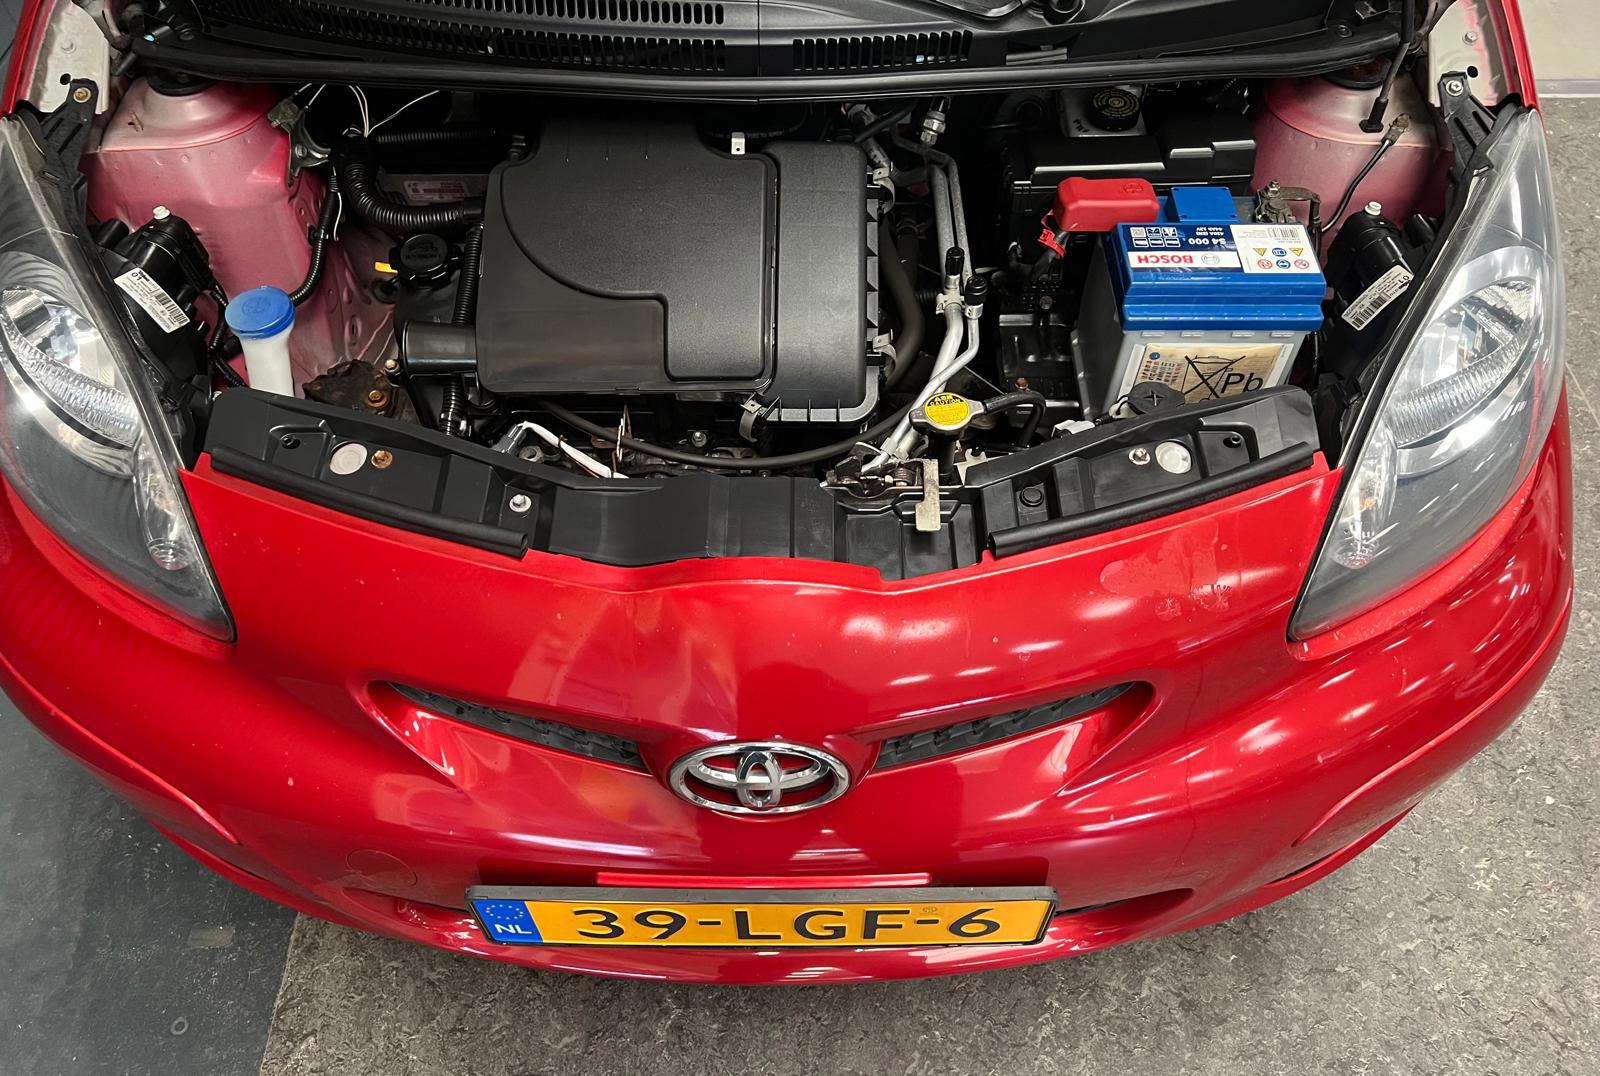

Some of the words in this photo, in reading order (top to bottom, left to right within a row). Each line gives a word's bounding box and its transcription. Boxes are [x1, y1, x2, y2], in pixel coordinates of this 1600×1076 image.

[1137, 255, 1194, 264] BOSCH
[1220, 372, 1263, 393] Pb
[494, 923, 533, 935] NL
[575, 908, 1001, 940] 39-LGF-6
